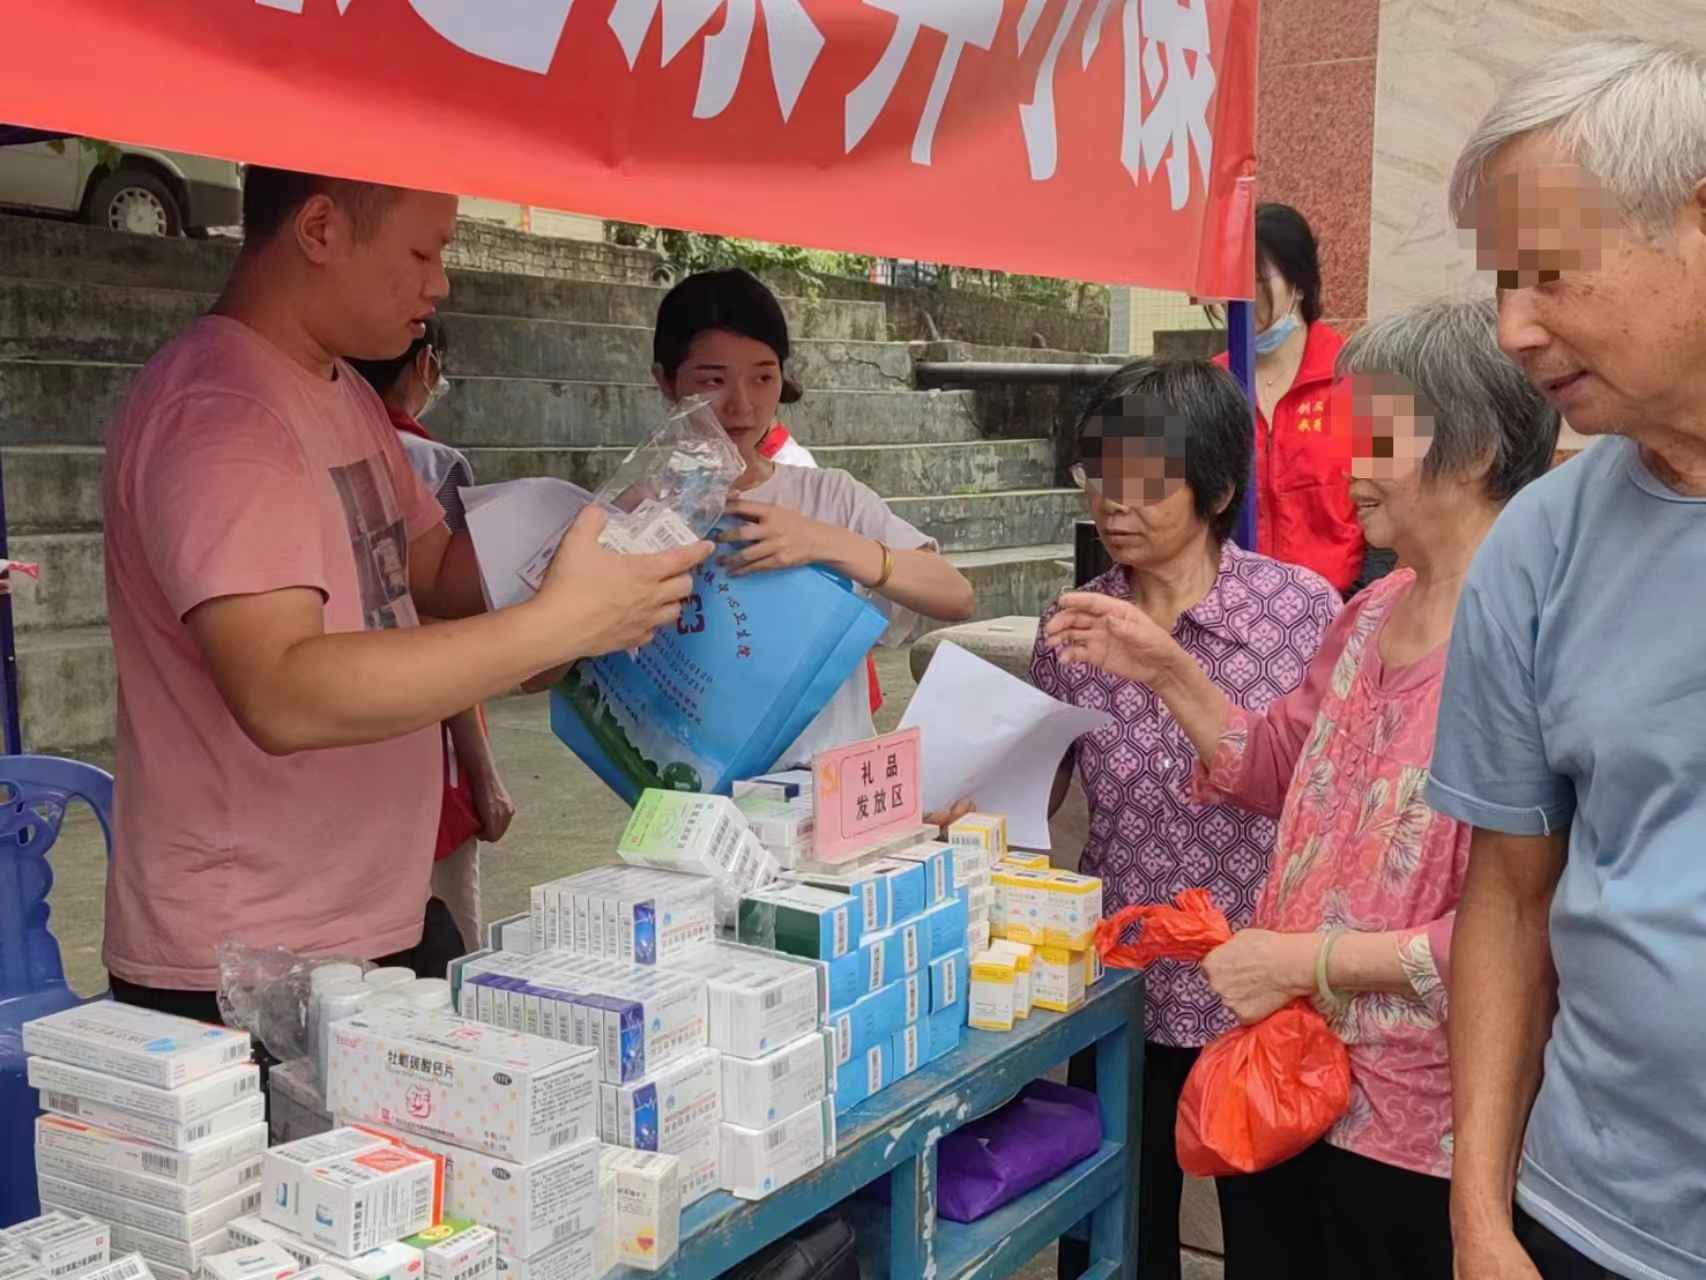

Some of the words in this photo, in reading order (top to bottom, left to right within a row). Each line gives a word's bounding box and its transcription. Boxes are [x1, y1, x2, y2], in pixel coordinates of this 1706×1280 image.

[861, 753, 898, 787] 礼品
[856, 783, 903, 821] 发放区
[387, 1050, 454, 1080] 牡蛎碳酸钙片
